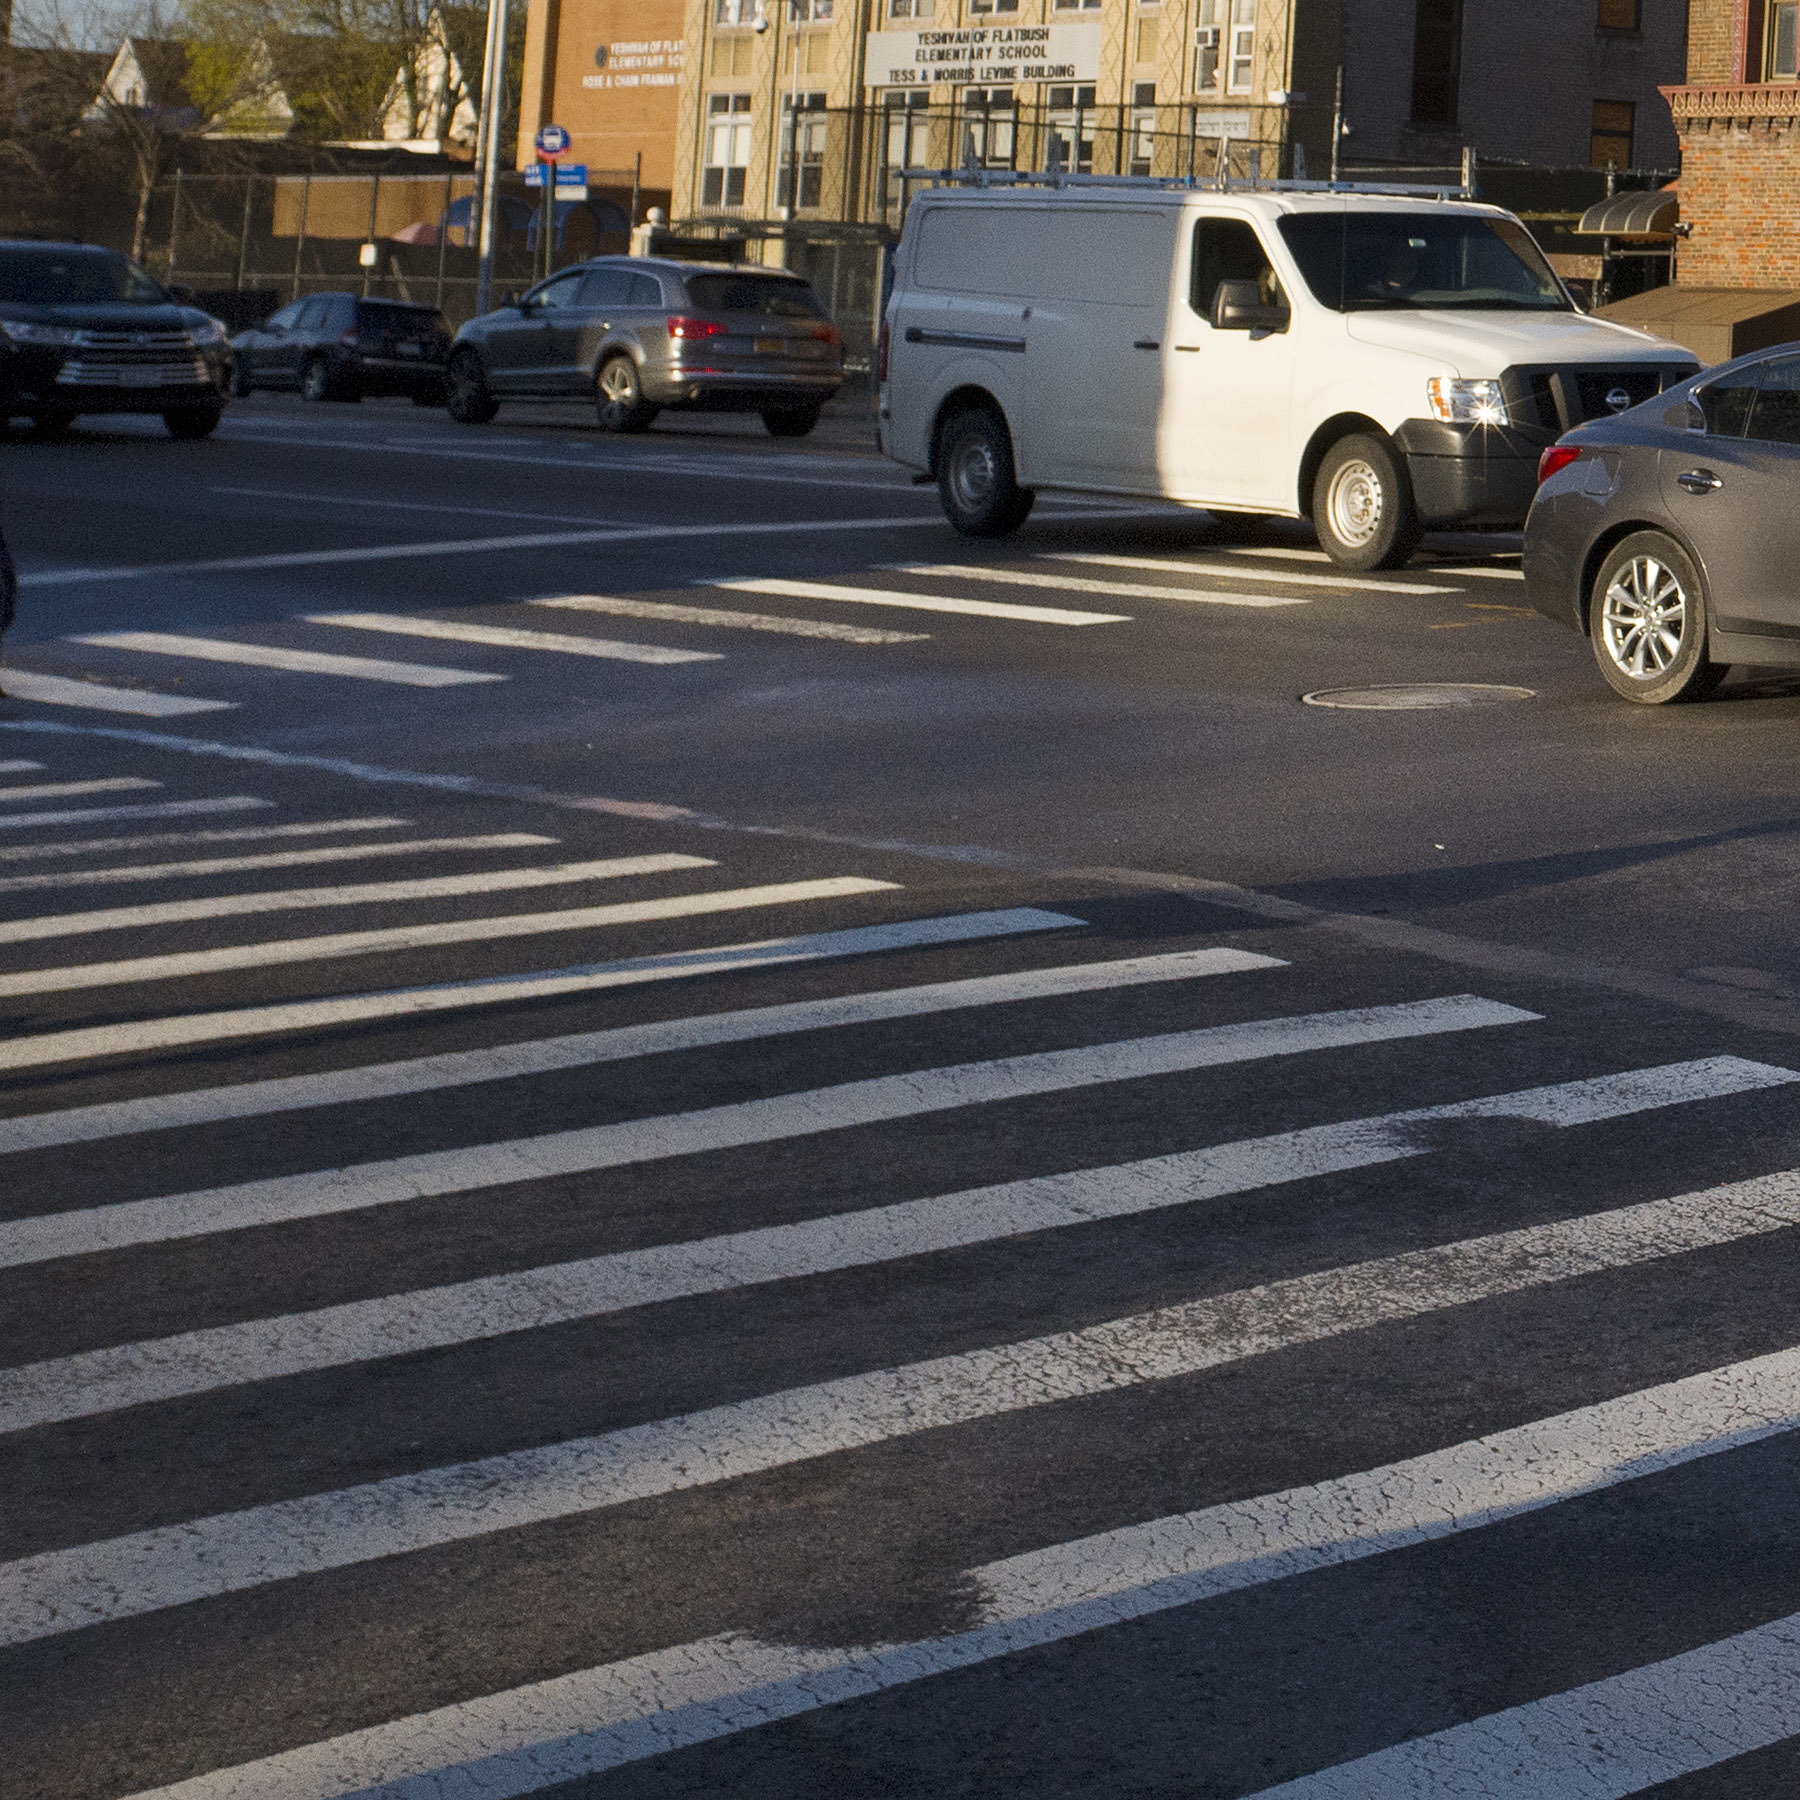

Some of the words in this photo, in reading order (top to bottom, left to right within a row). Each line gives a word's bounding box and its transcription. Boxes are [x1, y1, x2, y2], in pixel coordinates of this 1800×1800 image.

[973, 30, 988, 43] OF
[993, 28, 1049, 42] FLATBUSH
[915, 47, 992, 62] ELEMENTARY
[999, 45, 1047, 60] SCHOOL
[889, 69, 915, 82] TESS
[921, 68, 928, 81] &
[934, 66, 975, 81] MORRIS
[980, 66, 1018, 80] LEVINE
[1023, 64, 1075, 79] BUILDING
